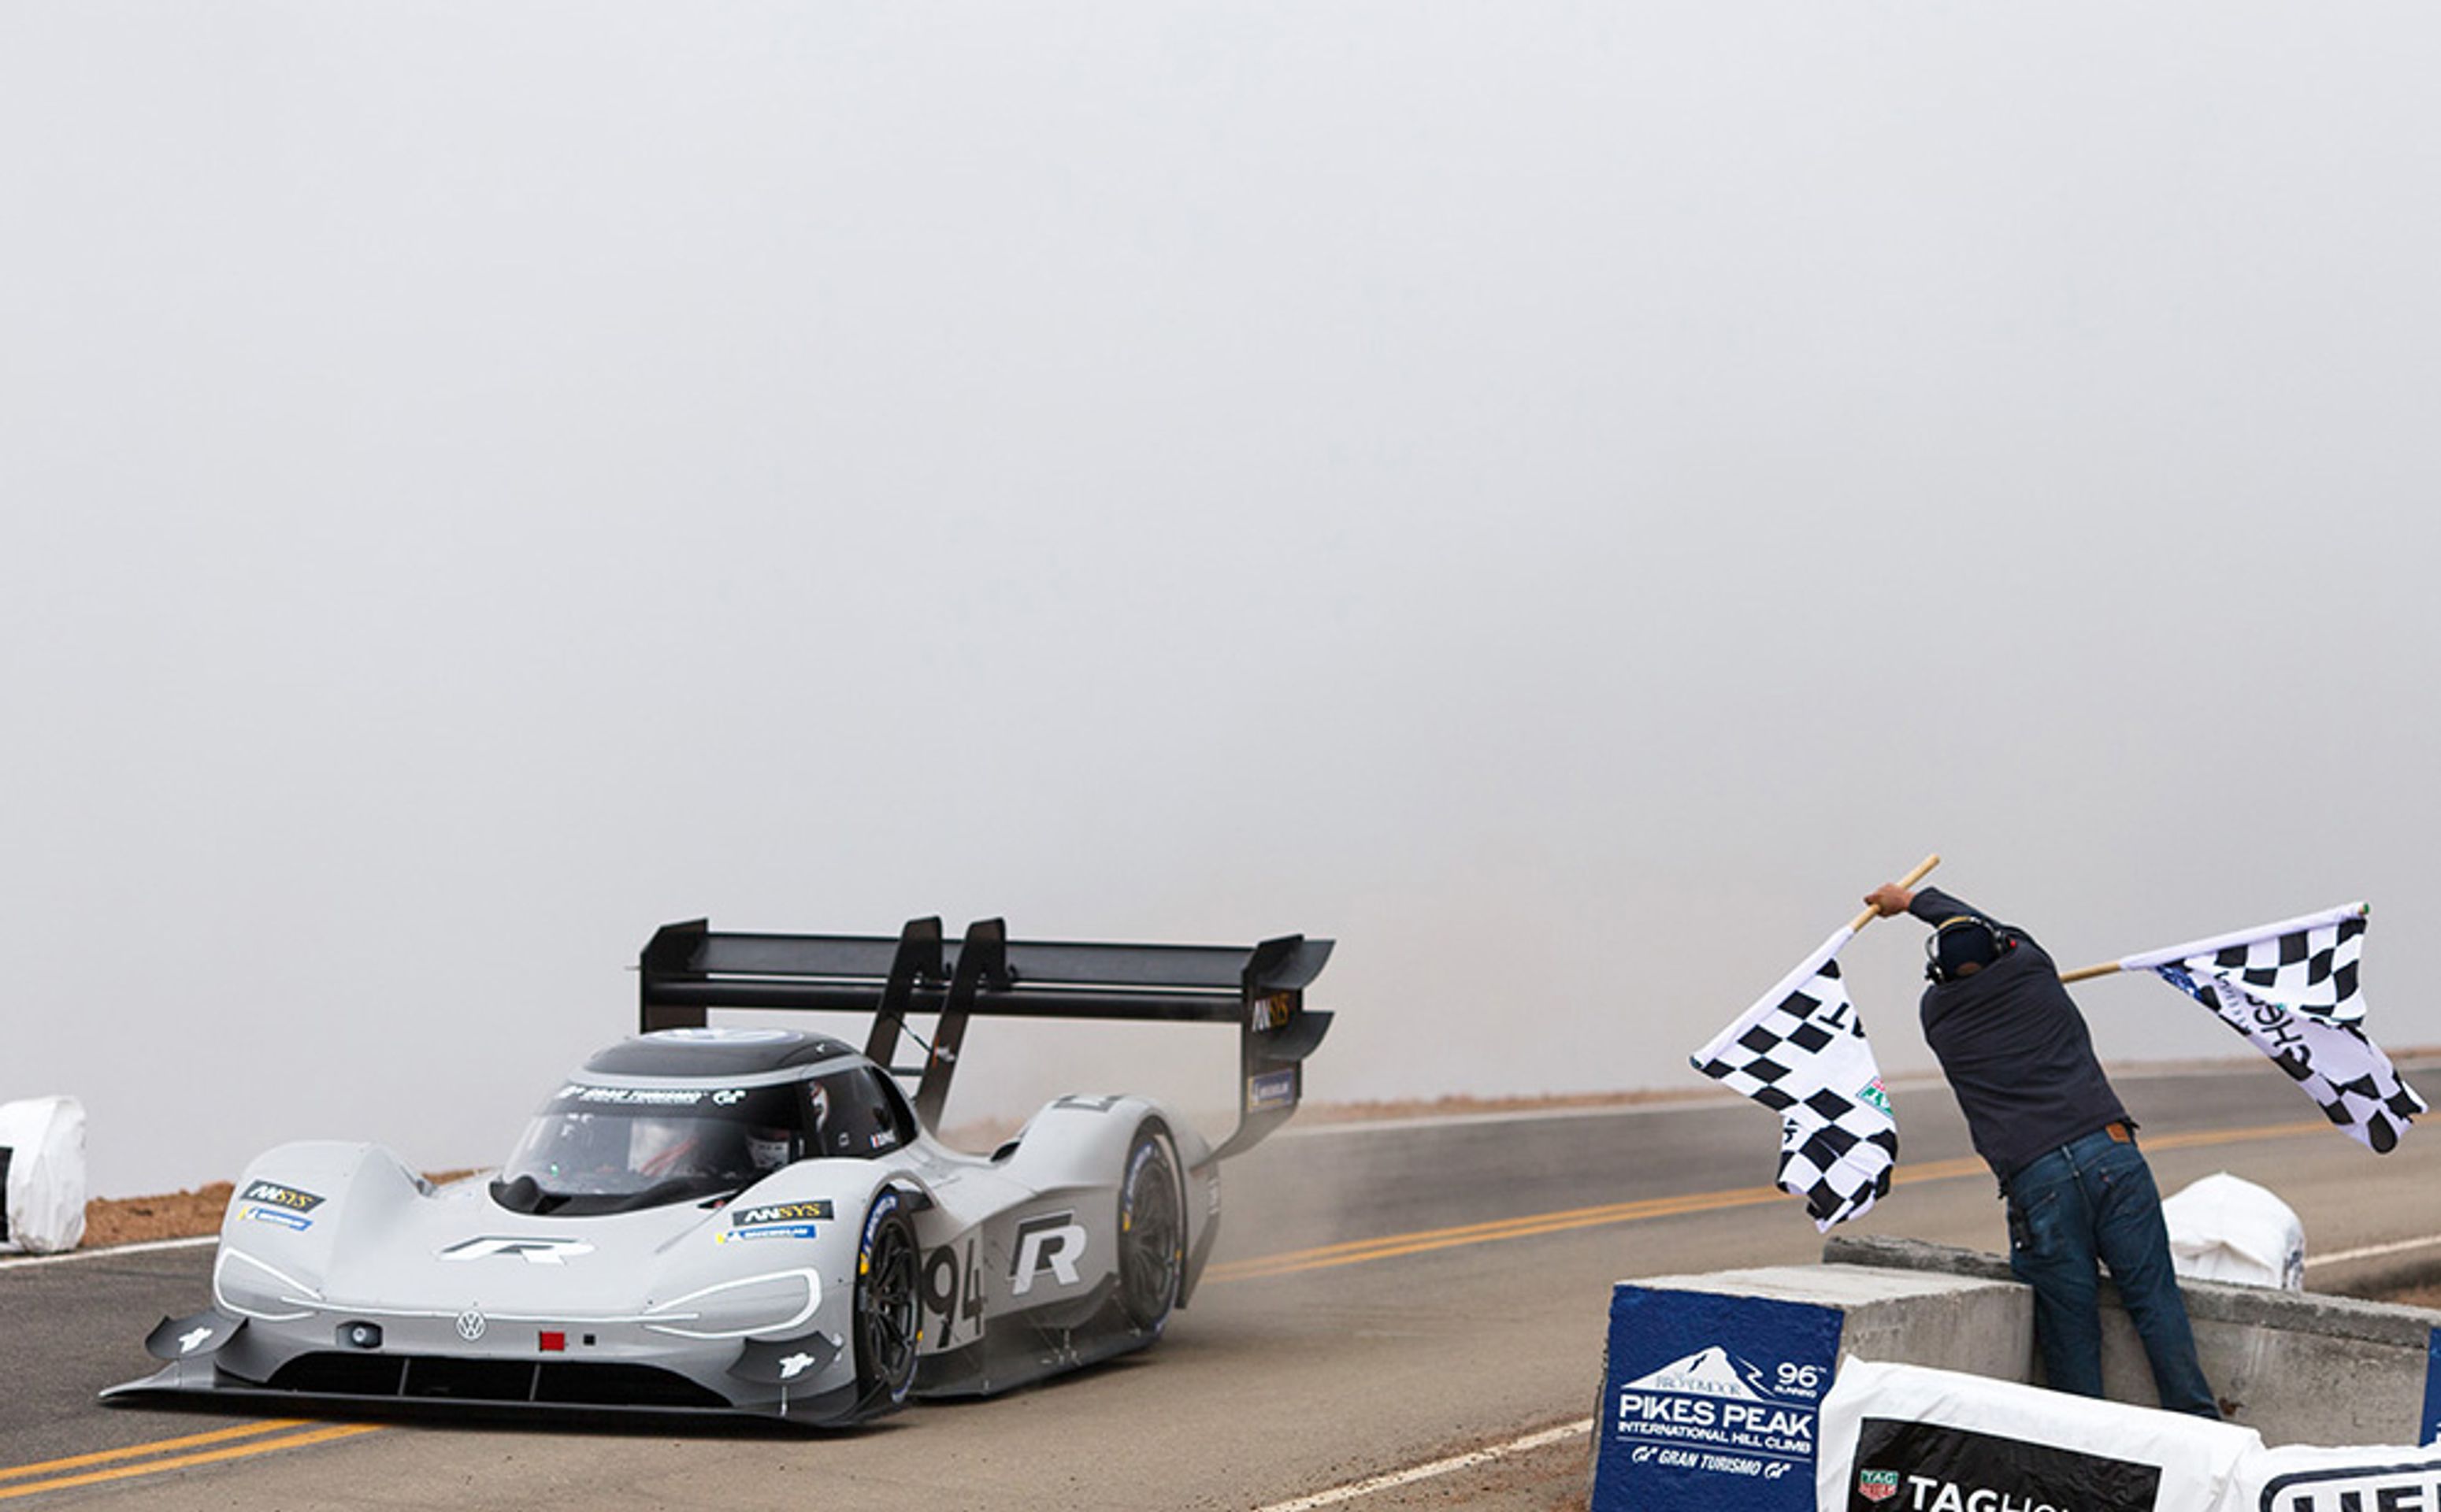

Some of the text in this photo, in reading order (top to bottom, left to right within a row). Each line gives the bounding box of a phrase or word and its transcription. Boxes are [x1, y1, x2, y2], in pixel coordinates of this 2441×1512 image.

[744, 1203, 822, 1222] ANSYS
[1008, 1213, 1086, 1295] R
[921, 1238, 983, 1349] 94
[1619, 1394, 1812, 1440] PIKES PEAK
[1618, 1421, 1812, 1454] INTERNATIONAL HILL CLIMB
[1658, 1449, 1699, 1468] GRAN
[1701, 1453, 1762, 1477] TURISMO
